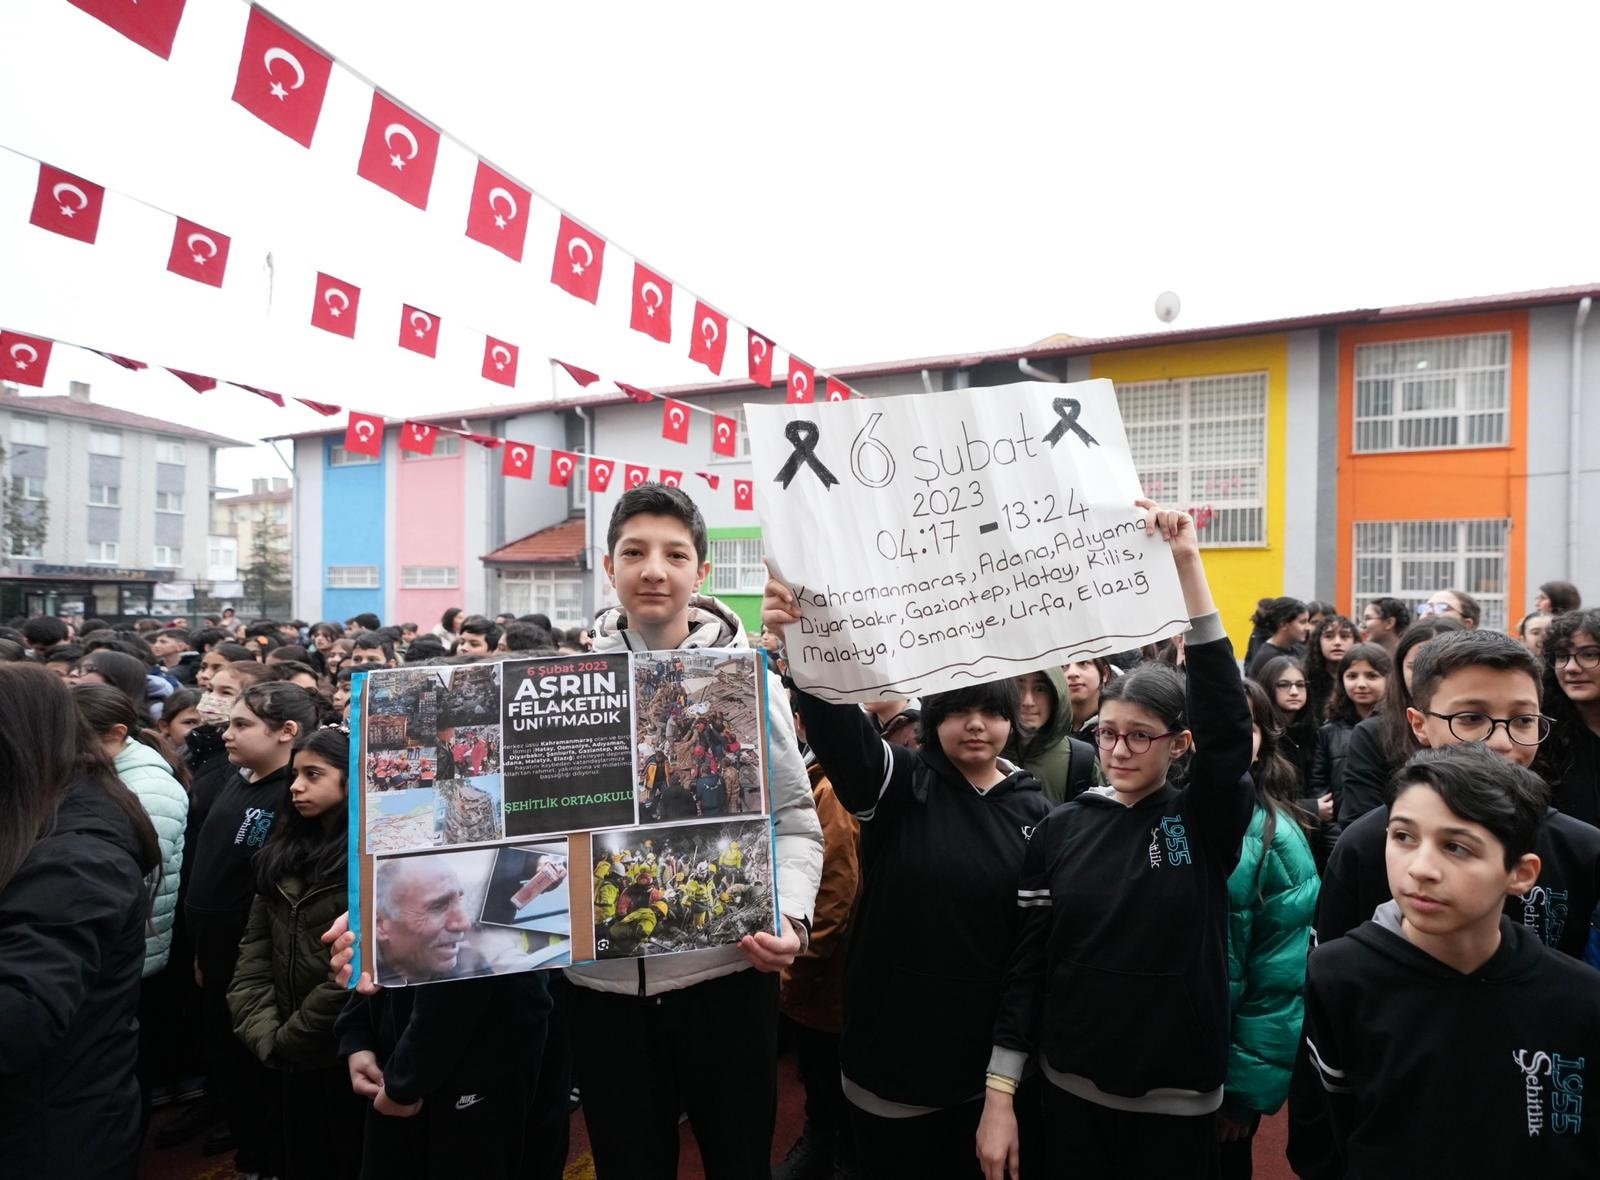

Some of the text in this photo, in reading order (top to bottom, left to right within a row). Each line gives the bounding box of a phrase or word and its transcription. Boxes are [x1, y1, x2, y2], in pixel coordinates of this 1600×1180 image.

[850, 412, 896, 489] 6
[912, 480, 985, 518] 2023
[876, 520, 960, 563] 04:17
[1053, 518, 1147, 552] Adıyama
[513, 671, 616, 701] ASRIN
[527, 660, 609, 678] 6 Şubat 2023
[508, 690, 628, 717] FELAKETİNİ
[504, 790, 634, 814] ŞEHİTLİK ORTAOKULU
[1161, 814, 1192, 866] 1955
[1551, 1052, 1585, 1135] 1955
